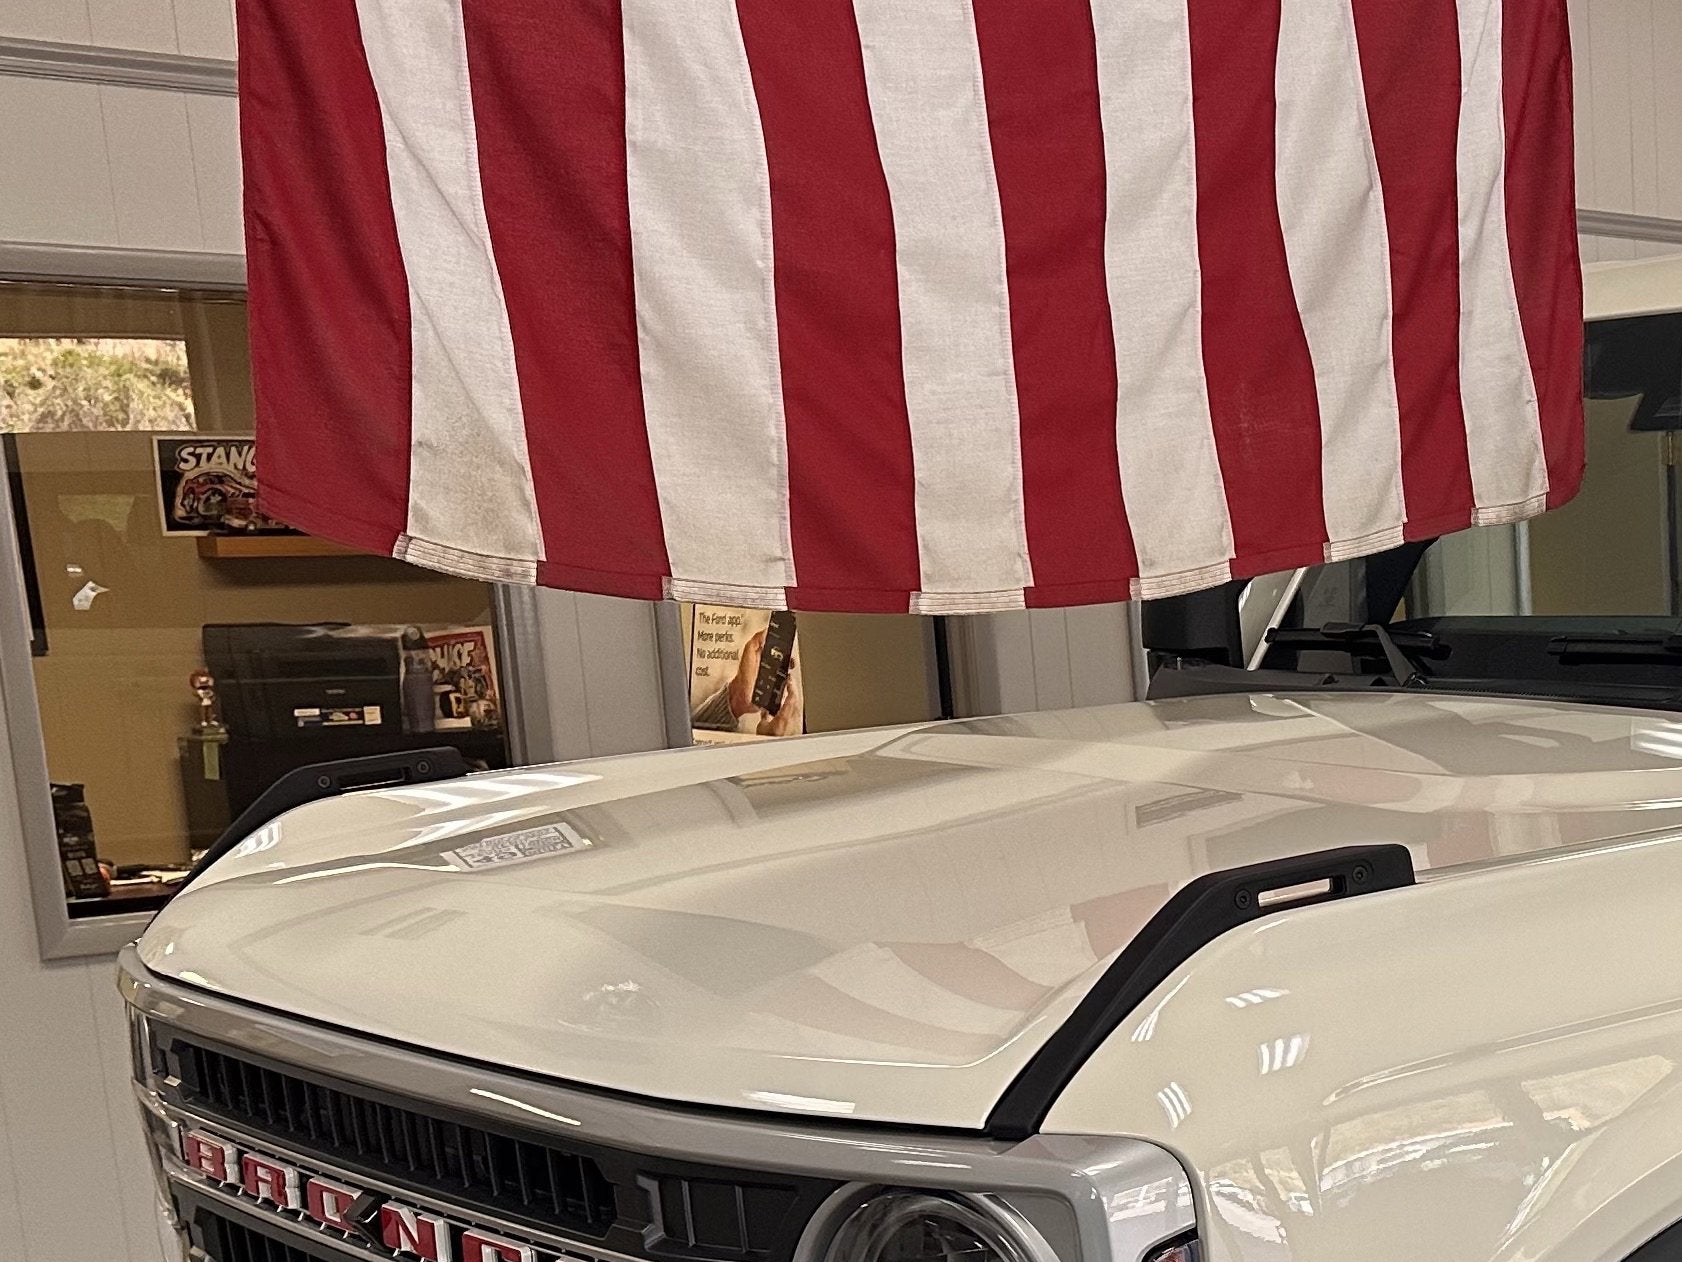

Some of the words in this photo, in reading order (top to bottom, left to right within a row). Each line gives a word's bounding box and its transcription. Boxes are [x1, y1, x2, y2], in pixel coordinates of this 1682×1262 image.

[699, 612, 710, 625] The
[711, 612, 727, 625] Ford
[697, 630, 714, 642] More
[696, 647, 706, 659] No
